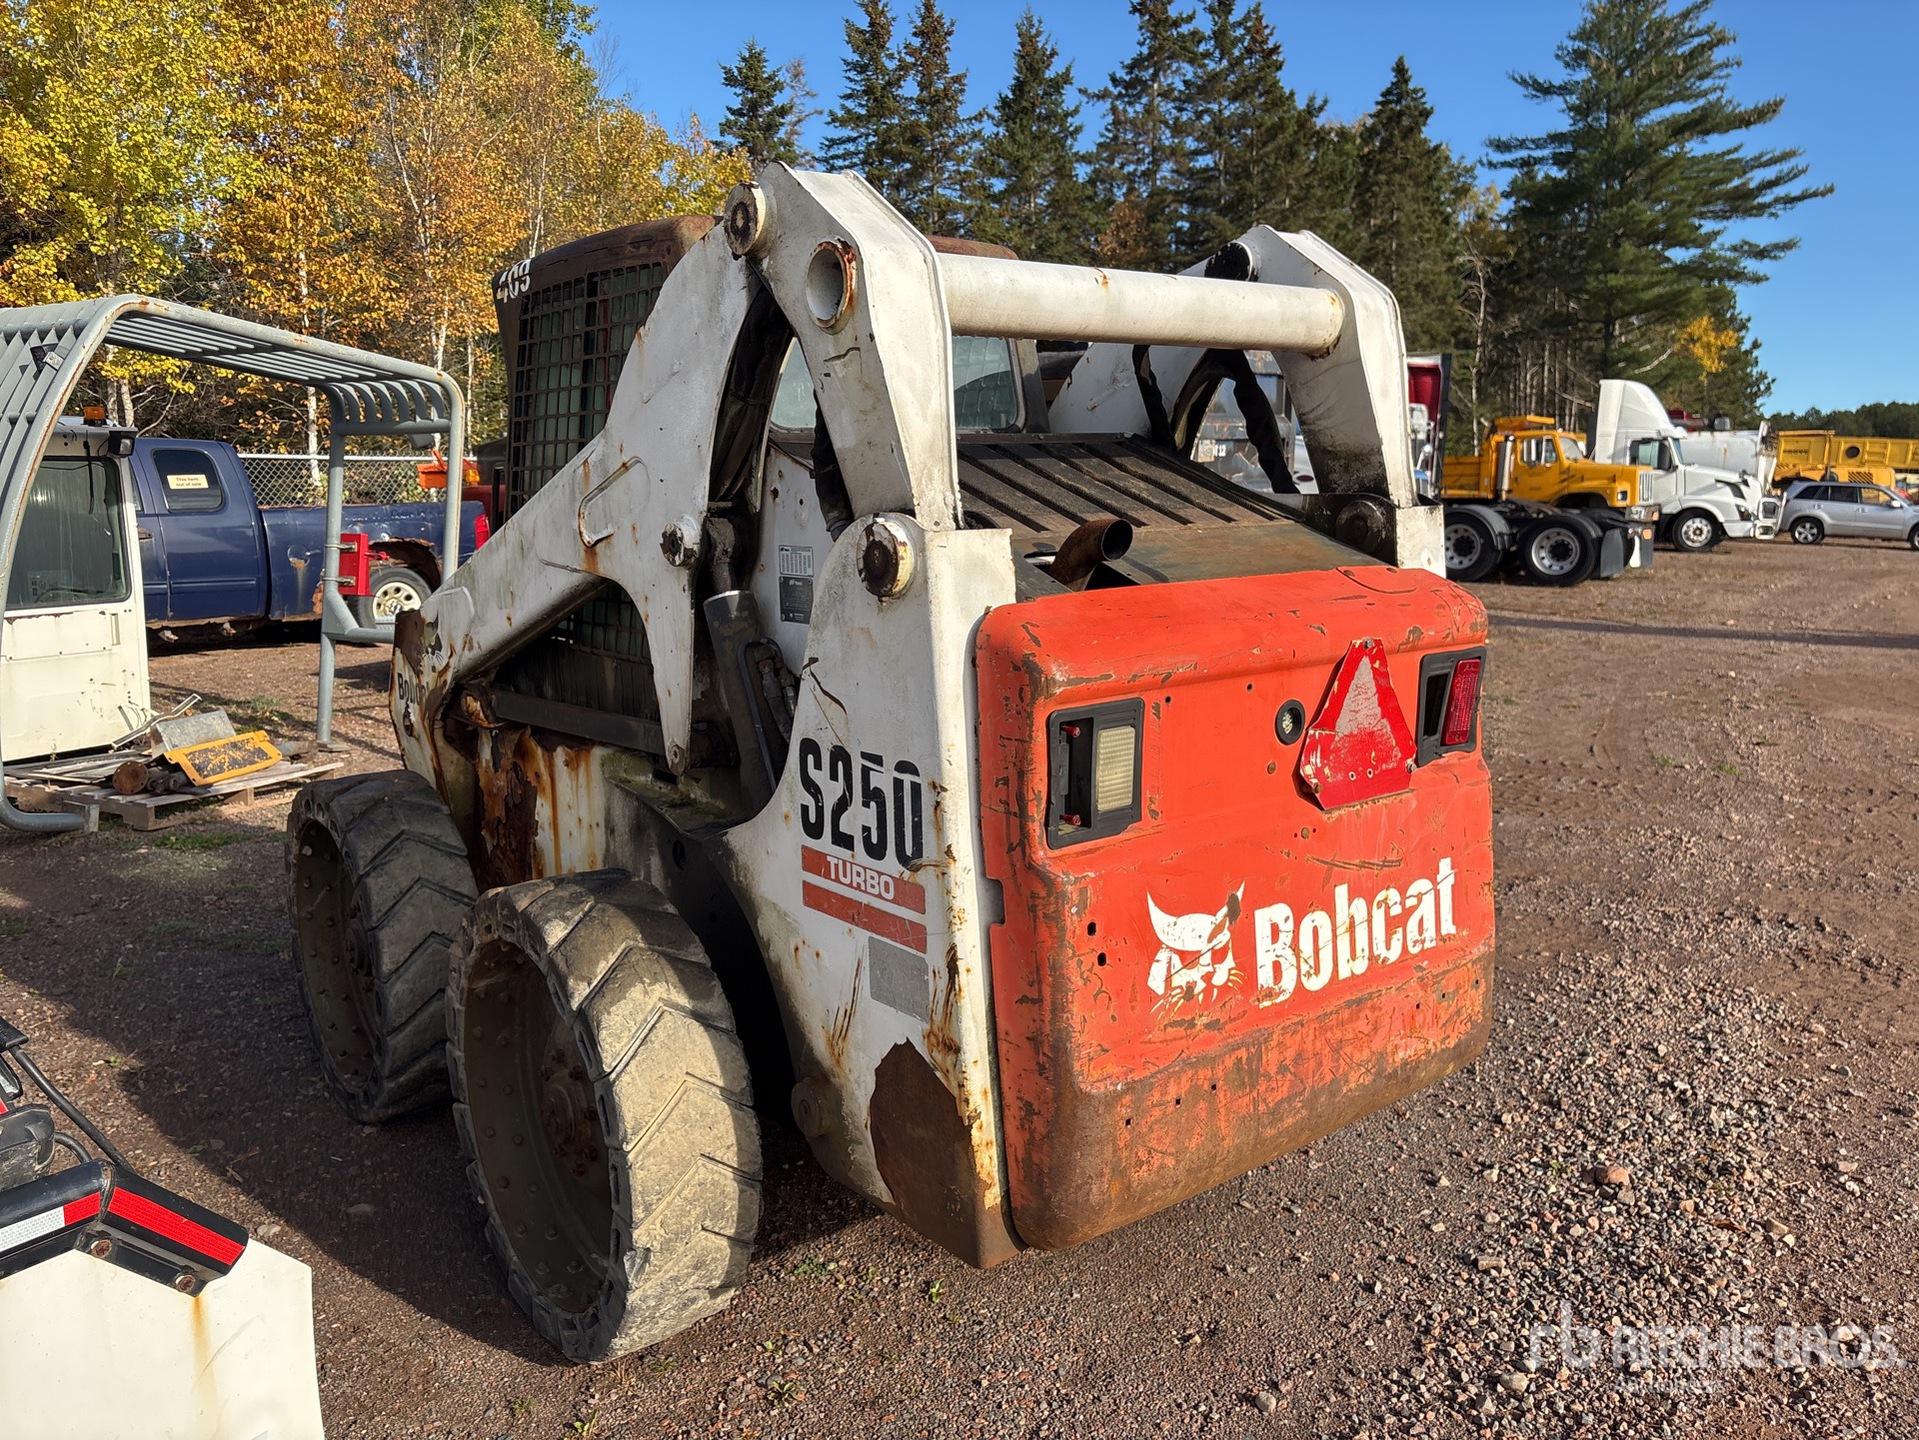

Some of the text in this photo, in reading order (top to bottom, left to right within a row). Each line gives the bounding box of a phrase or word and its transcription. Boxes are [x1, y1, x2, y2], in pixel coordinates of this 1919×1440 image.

[496, 259, 531, 303] 409
[799, 737, 924, 873] S250
[826, 855, 895, 900] TURBO
[1254, 856, 1457, 1009] Bobcat
